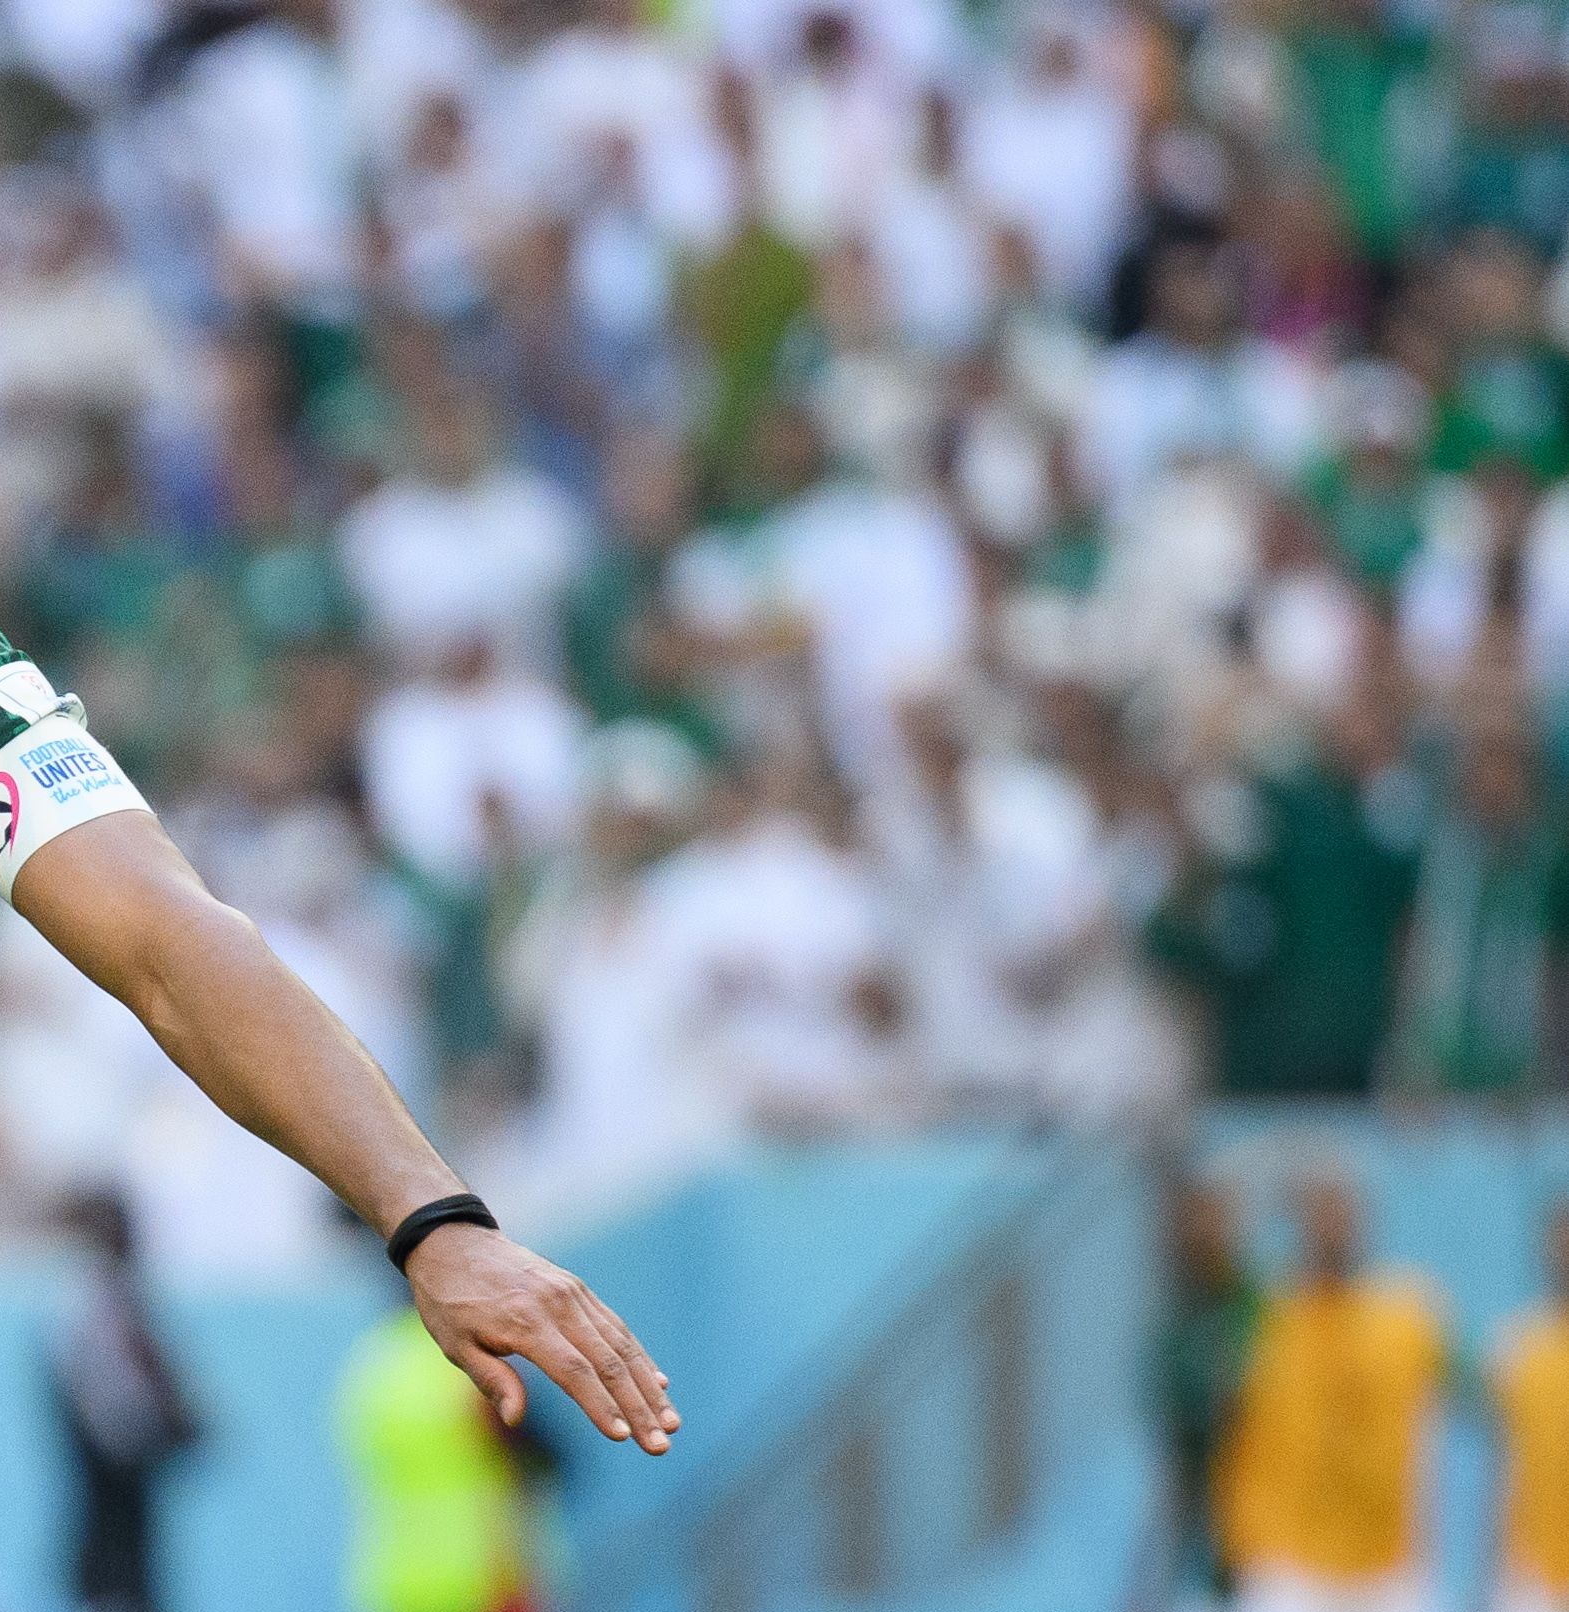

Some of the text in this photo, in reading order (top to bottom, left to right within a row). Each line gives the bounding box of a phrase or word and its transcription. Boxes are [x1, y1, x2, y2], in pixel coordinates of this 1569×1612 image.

[18, 737, 92, 770] FOOTBALL
[31, 751, 107, 789] UNITES
[50, 786, 81, 804] the
